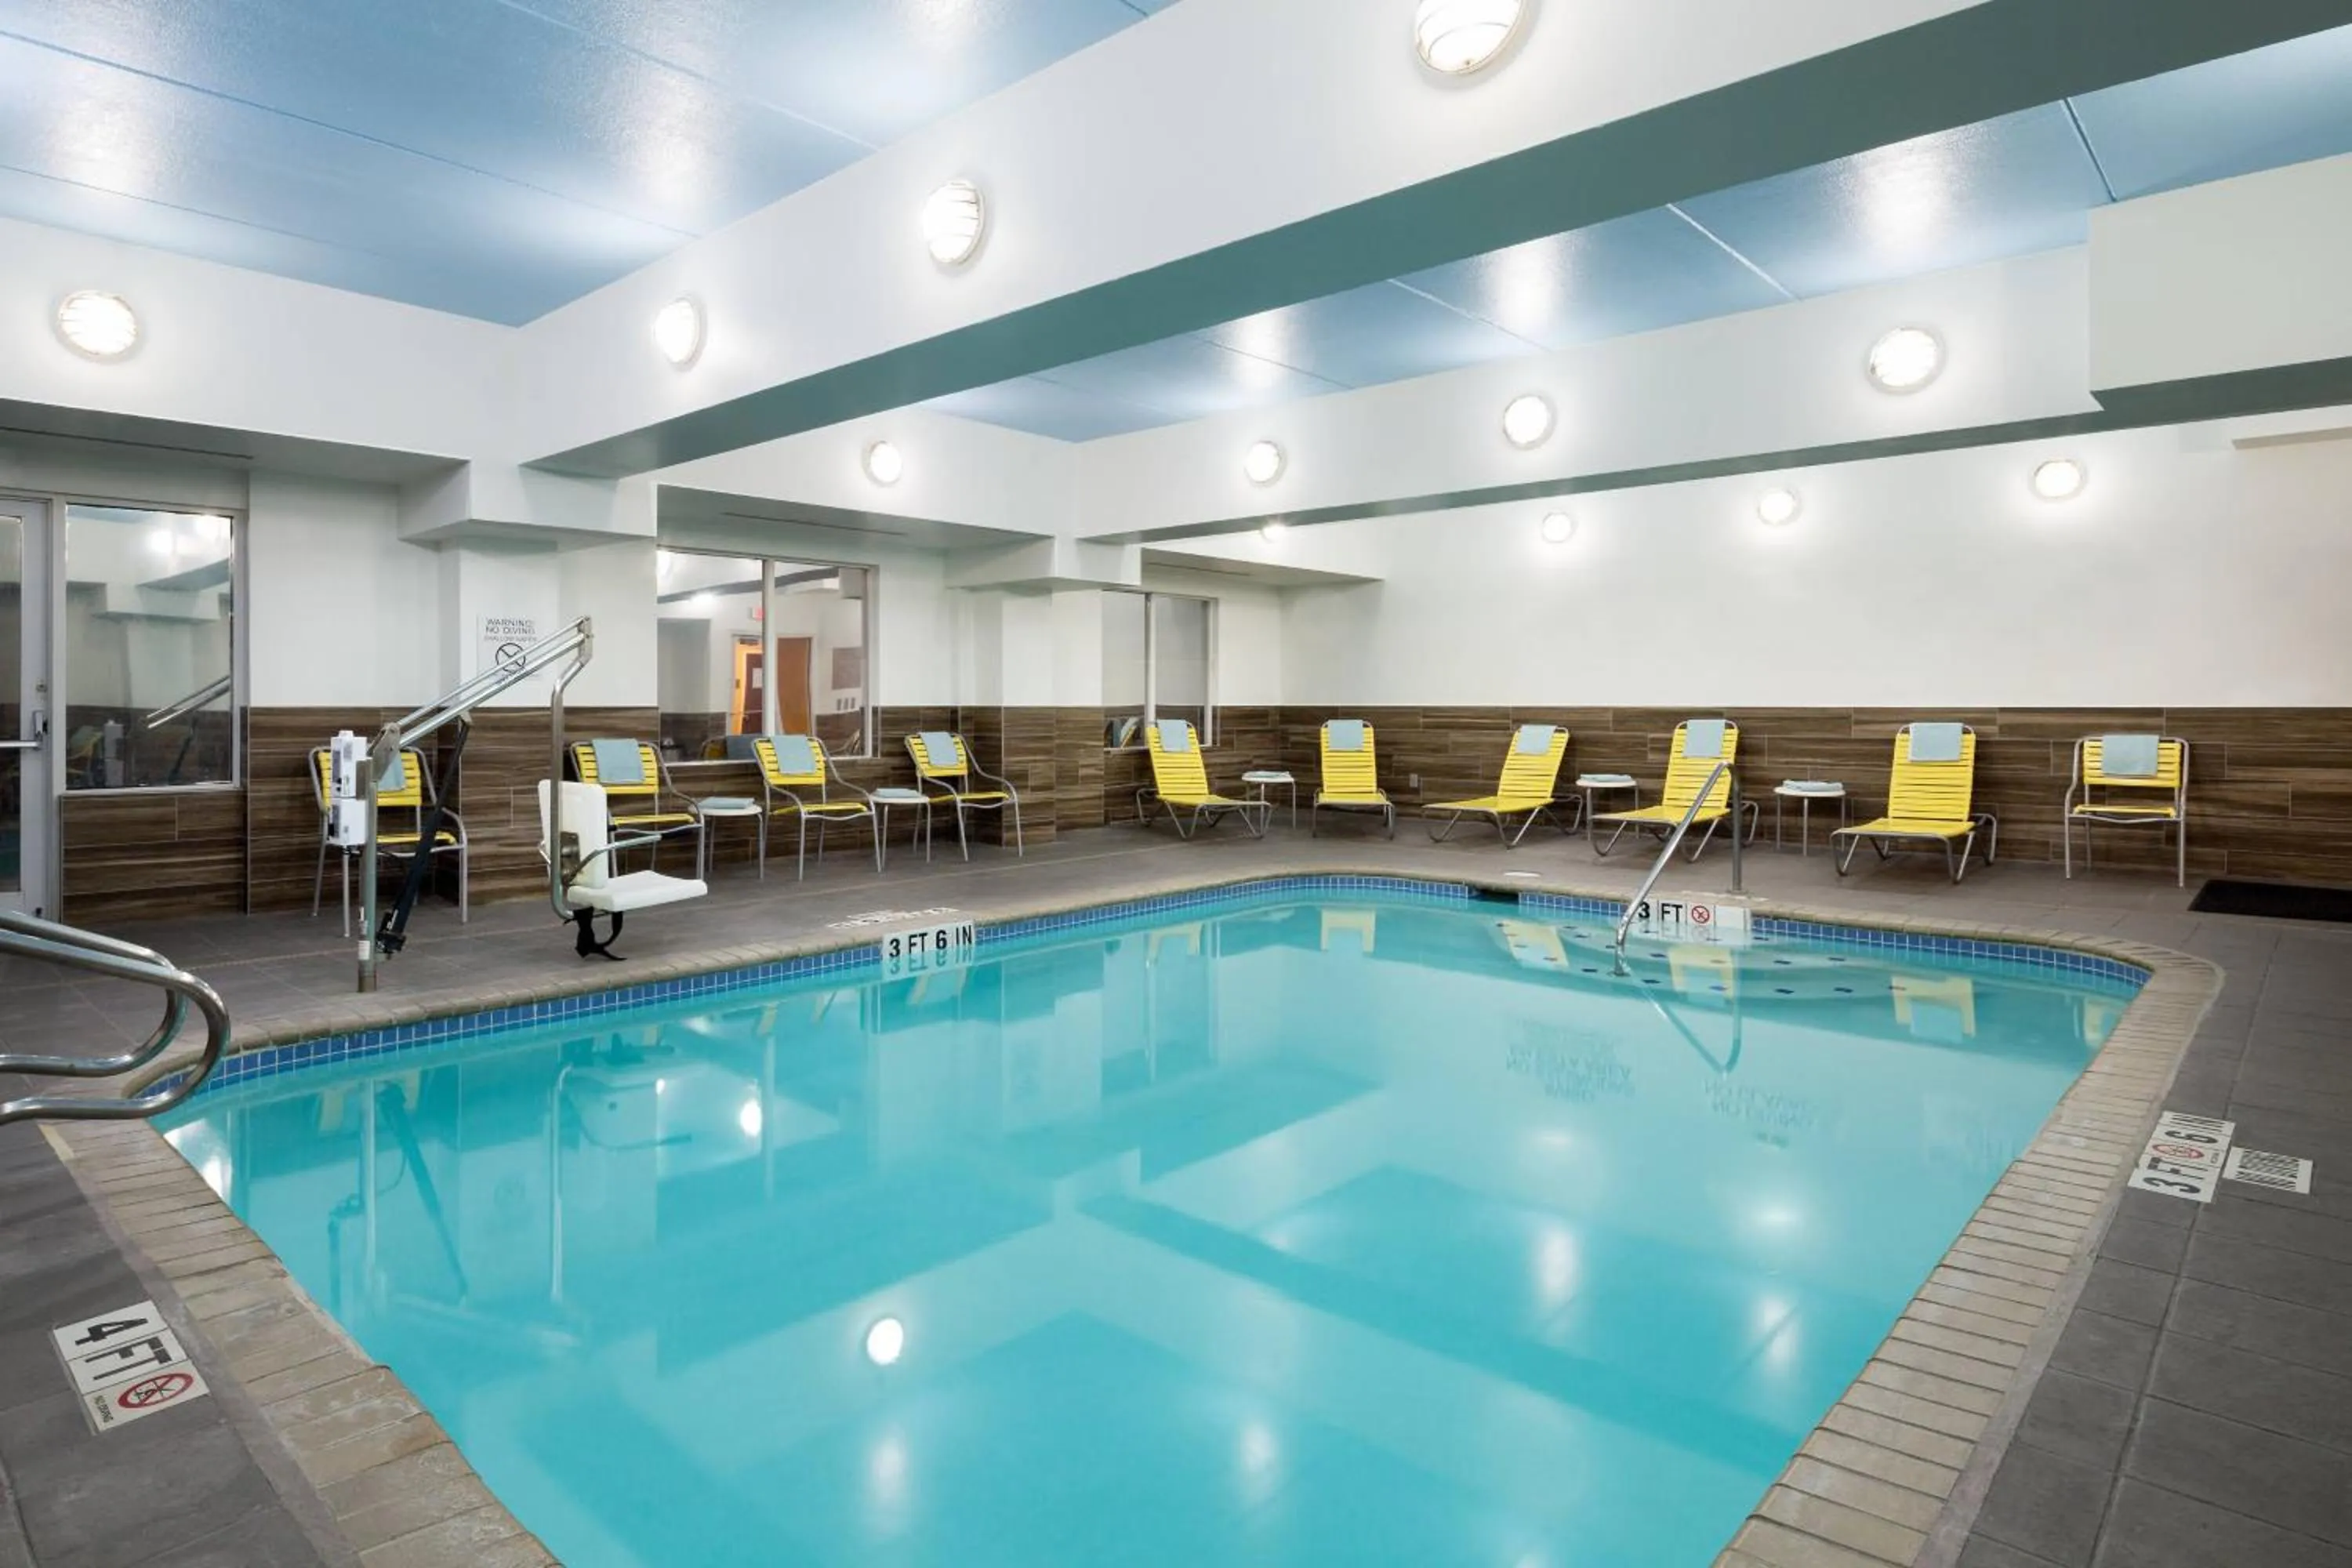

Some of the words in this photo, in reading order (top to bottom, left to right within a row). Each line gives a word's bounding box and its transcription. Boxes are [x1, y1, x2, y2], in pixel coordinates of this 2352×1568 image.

[1638, 901, 1650, 918] 3
[1661, 902, 1683, 923] FT
[888, 938, 901, 957] 3
[908, 932, 928, 954] FT
[935, 929, 947, 949] 6
[956, 924, 972, 945] IN
[2164, 1130, 2218, 1144] 6
[2147, 1156, 2209, 1181] FT
[2142, 1176, 2201, 1194] 3
[74, 1317, 148, 1346] 4
[85, 1336, 172, 1381] FT
